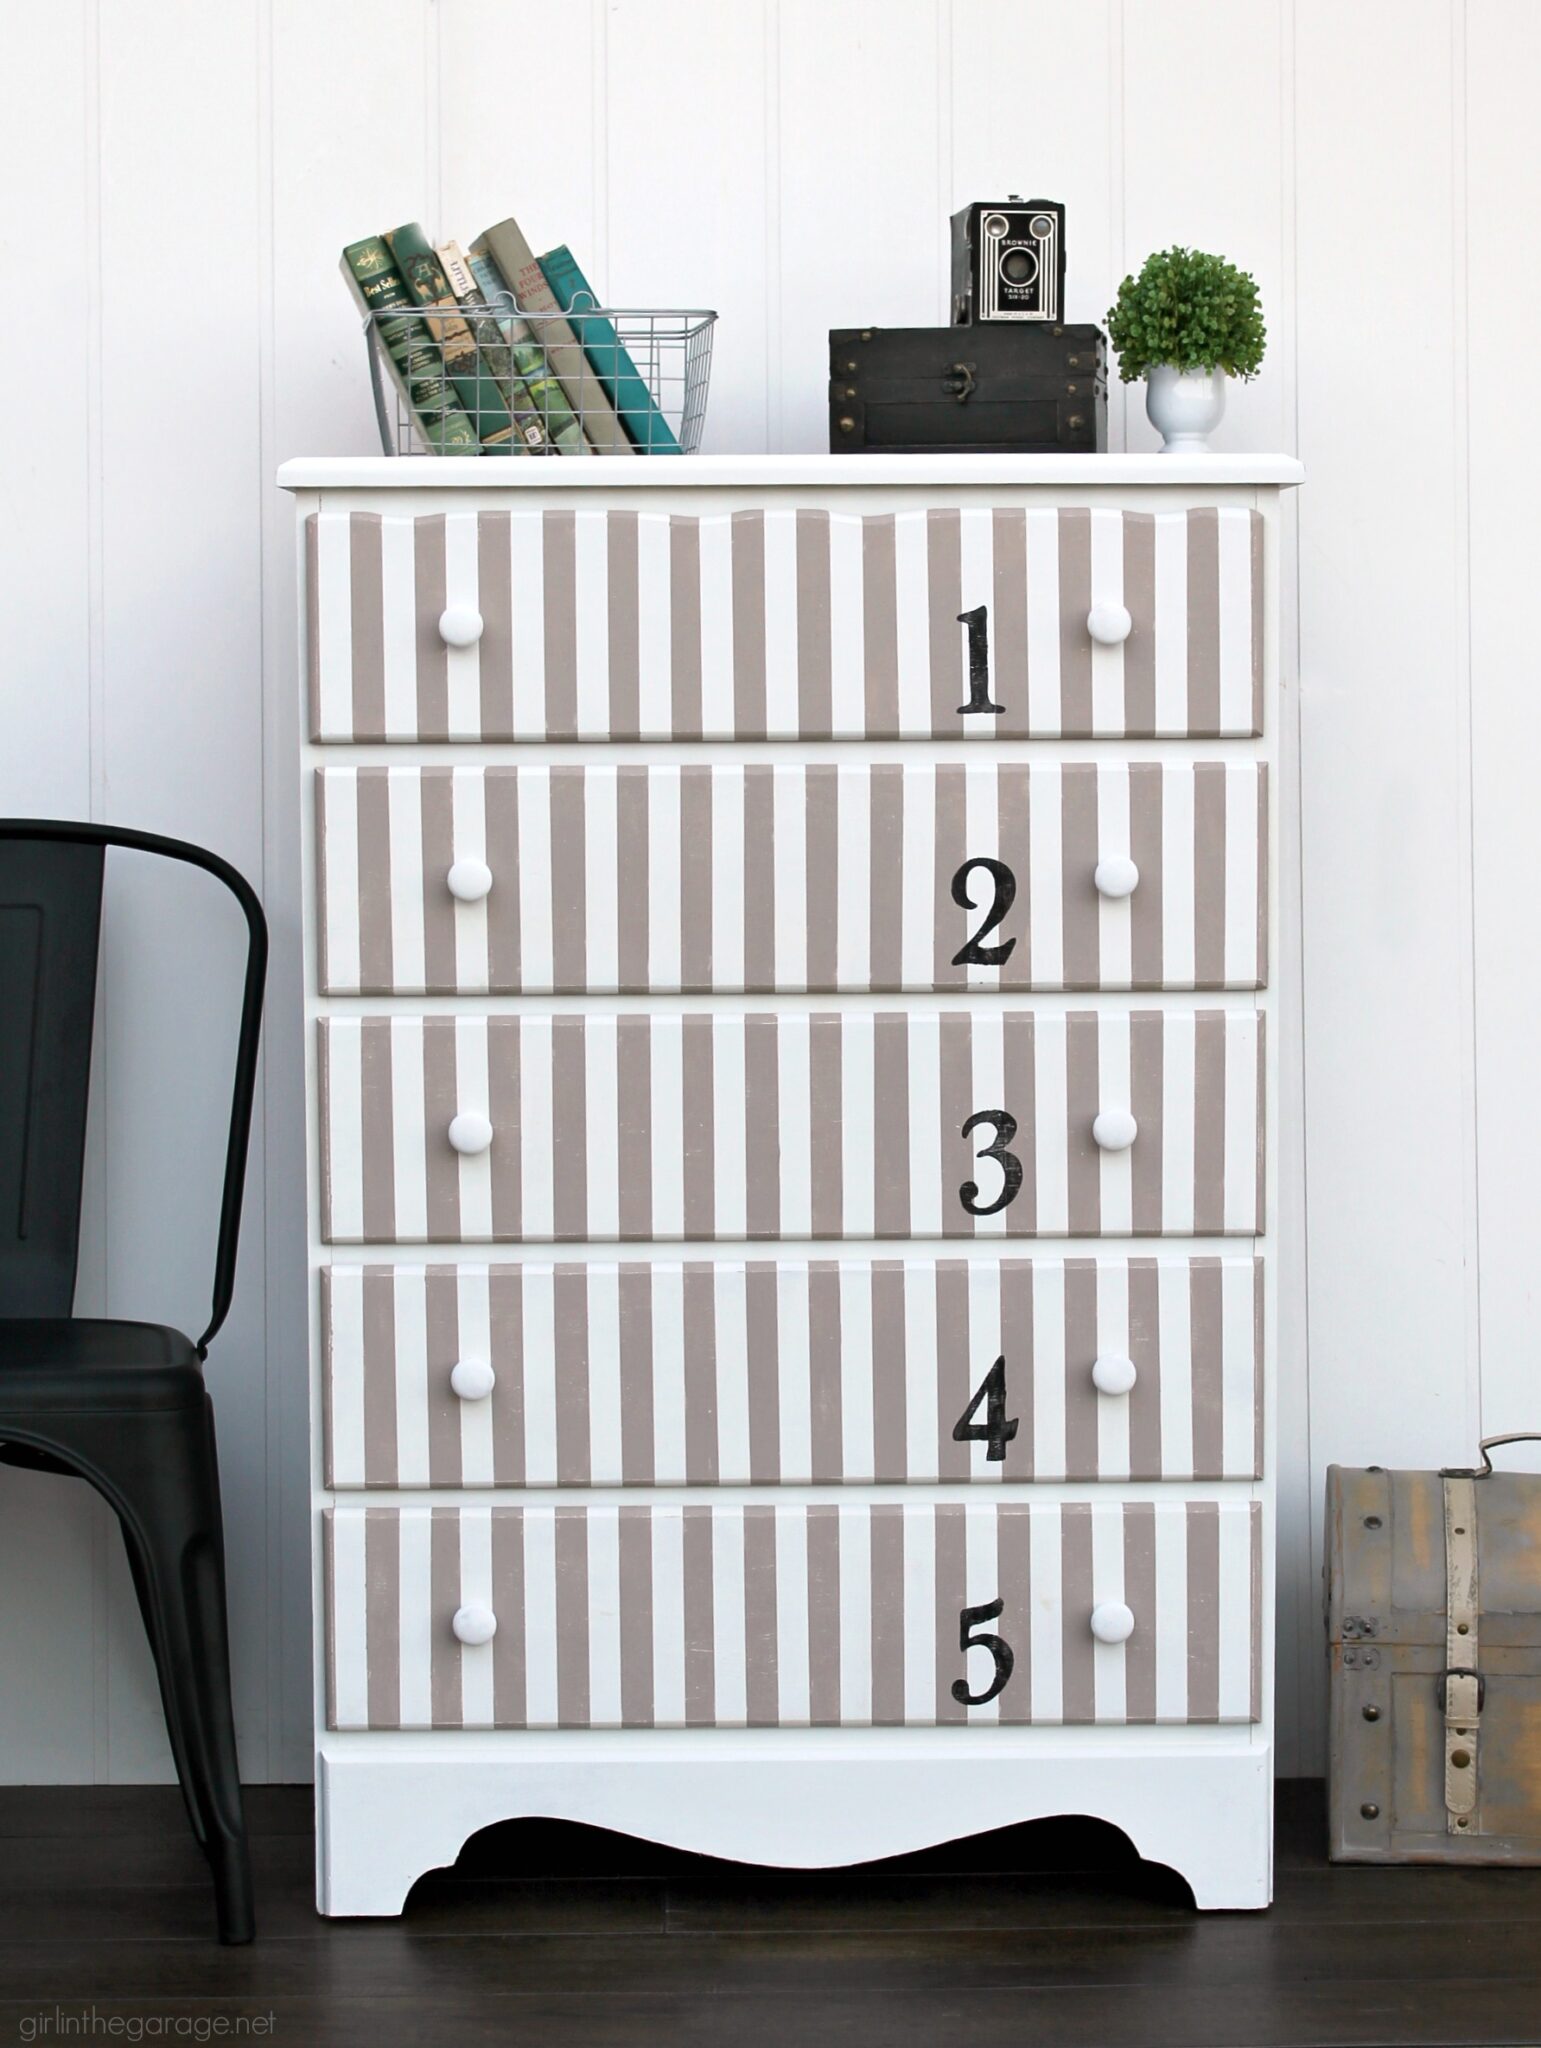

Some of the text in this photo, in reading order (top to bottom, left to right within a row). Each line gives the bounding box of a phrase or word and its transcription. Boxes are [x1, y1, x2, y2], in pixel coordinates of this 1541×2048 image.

[957, 605, 1006, 714] 1
[951, 857, 1017, 966] 2
[959, 1109, 1023, 1216] 3
[952, 1355, 1020, 1462] 4
[952, 1598, 1015, 1706] 5
